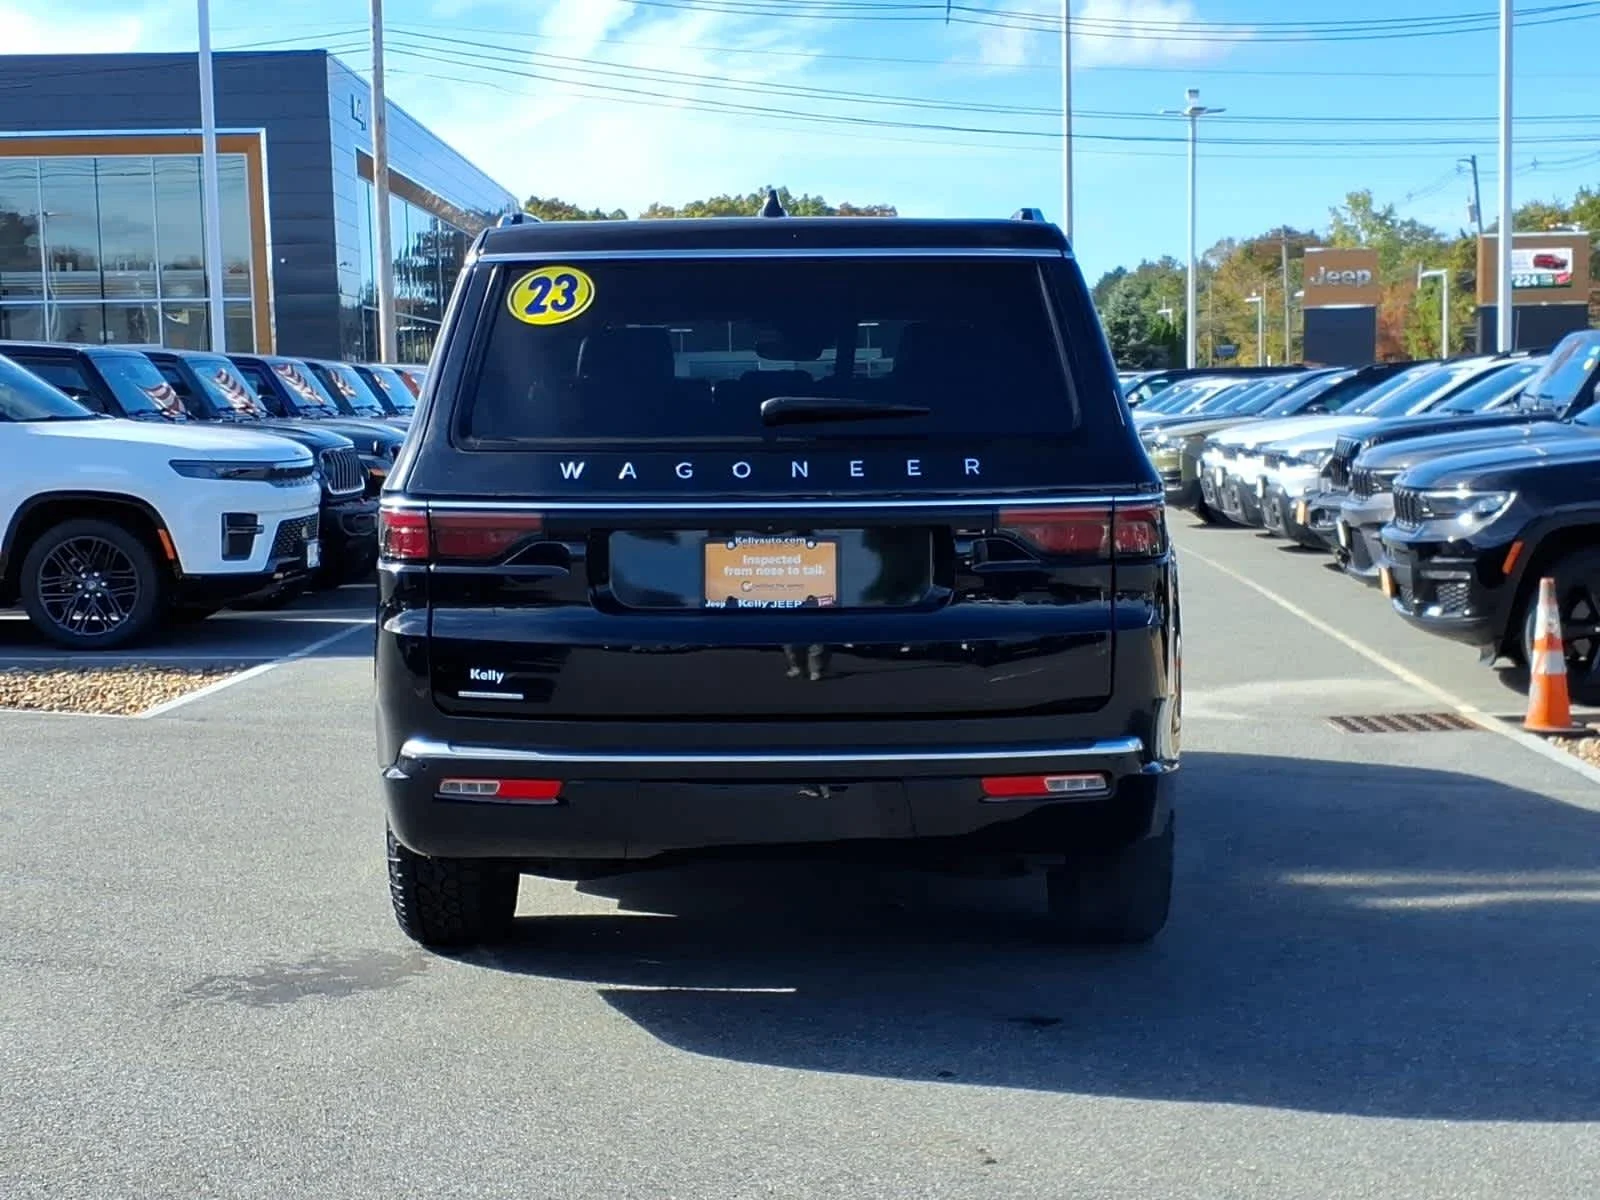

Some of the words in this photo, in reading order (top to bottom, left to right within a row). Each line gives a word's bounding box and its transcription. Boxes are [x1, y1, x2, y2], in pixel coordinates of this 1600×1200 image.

[1310, 266, 1371, 288] Jeep
[525, 273, 578, 315] 23
[560, 458, 980, 480] WAGONEER
[743, 554, 802, 566] Inspected
[724, 565, 753, 576] from
[787, 566, 800, 576] to
[705, 600, 726, 608] Jeep
[737, 599, 768, 609] Kelly
[770, 600, 802, 608] JEEP
[470, 668, 504, 684] Kelly
